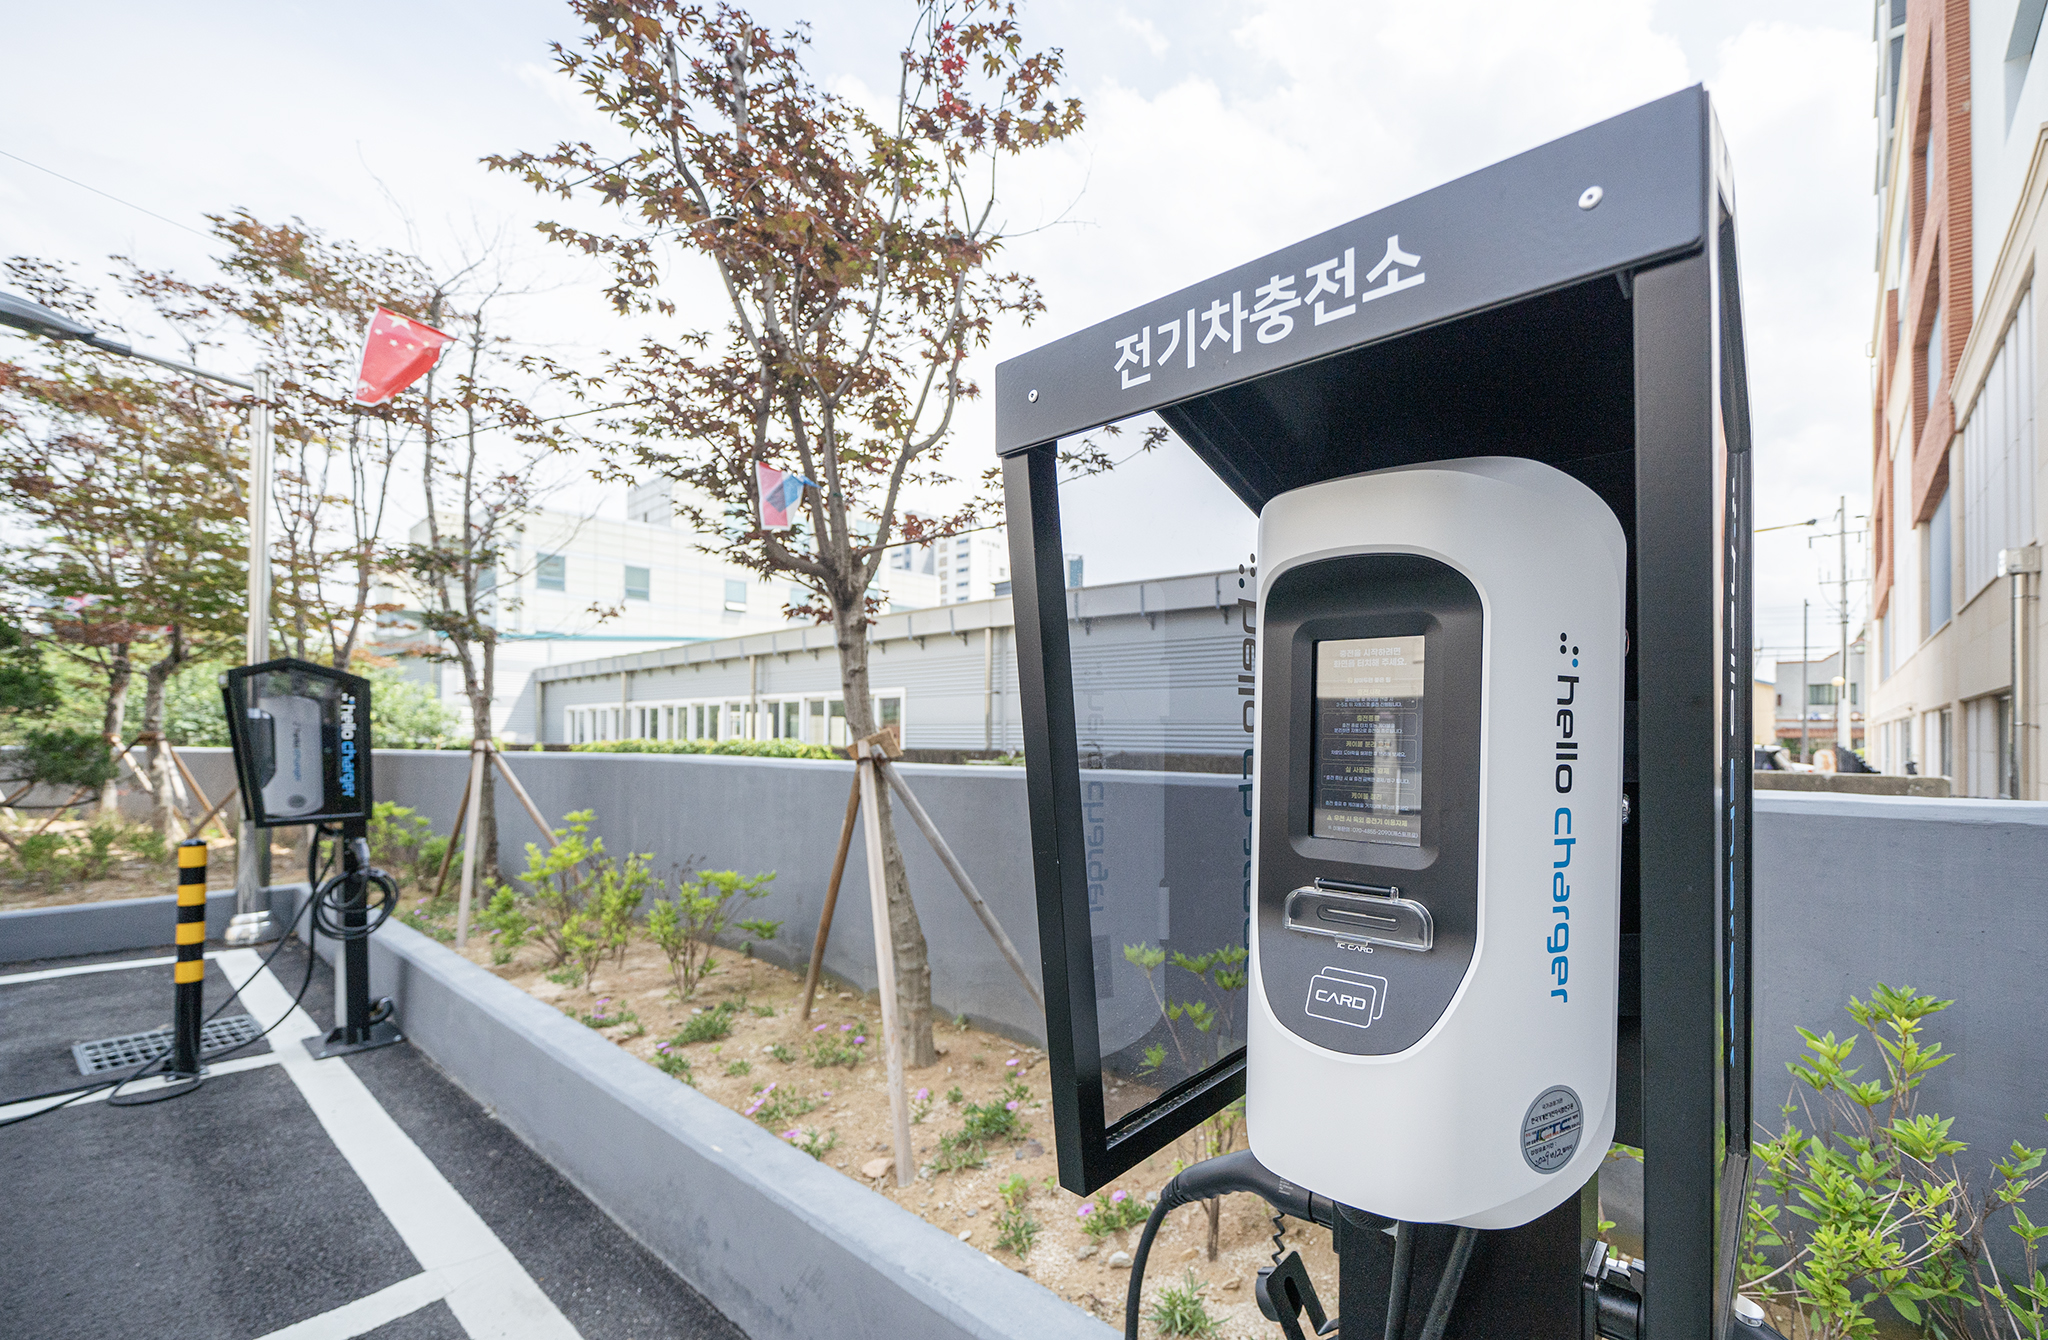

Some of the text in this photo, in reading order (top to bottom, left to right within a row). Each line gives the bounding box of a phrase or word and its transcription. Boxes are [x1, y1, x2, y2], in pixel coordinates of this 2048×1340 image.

[1113, 234, 1426, 391] 전기차충전소
[1333, 657, 1407, 668] 화면을 터치해 주세요.
[1340, 648, 1401, 658] 충전을 시작하려면
[339, 705, 356, 798] hello charger
[1547, 675, 1580, 1004] hello charger
[1348, 945, 1374, 954] CARD
[1315, 990, 1366, 1010] CARD
